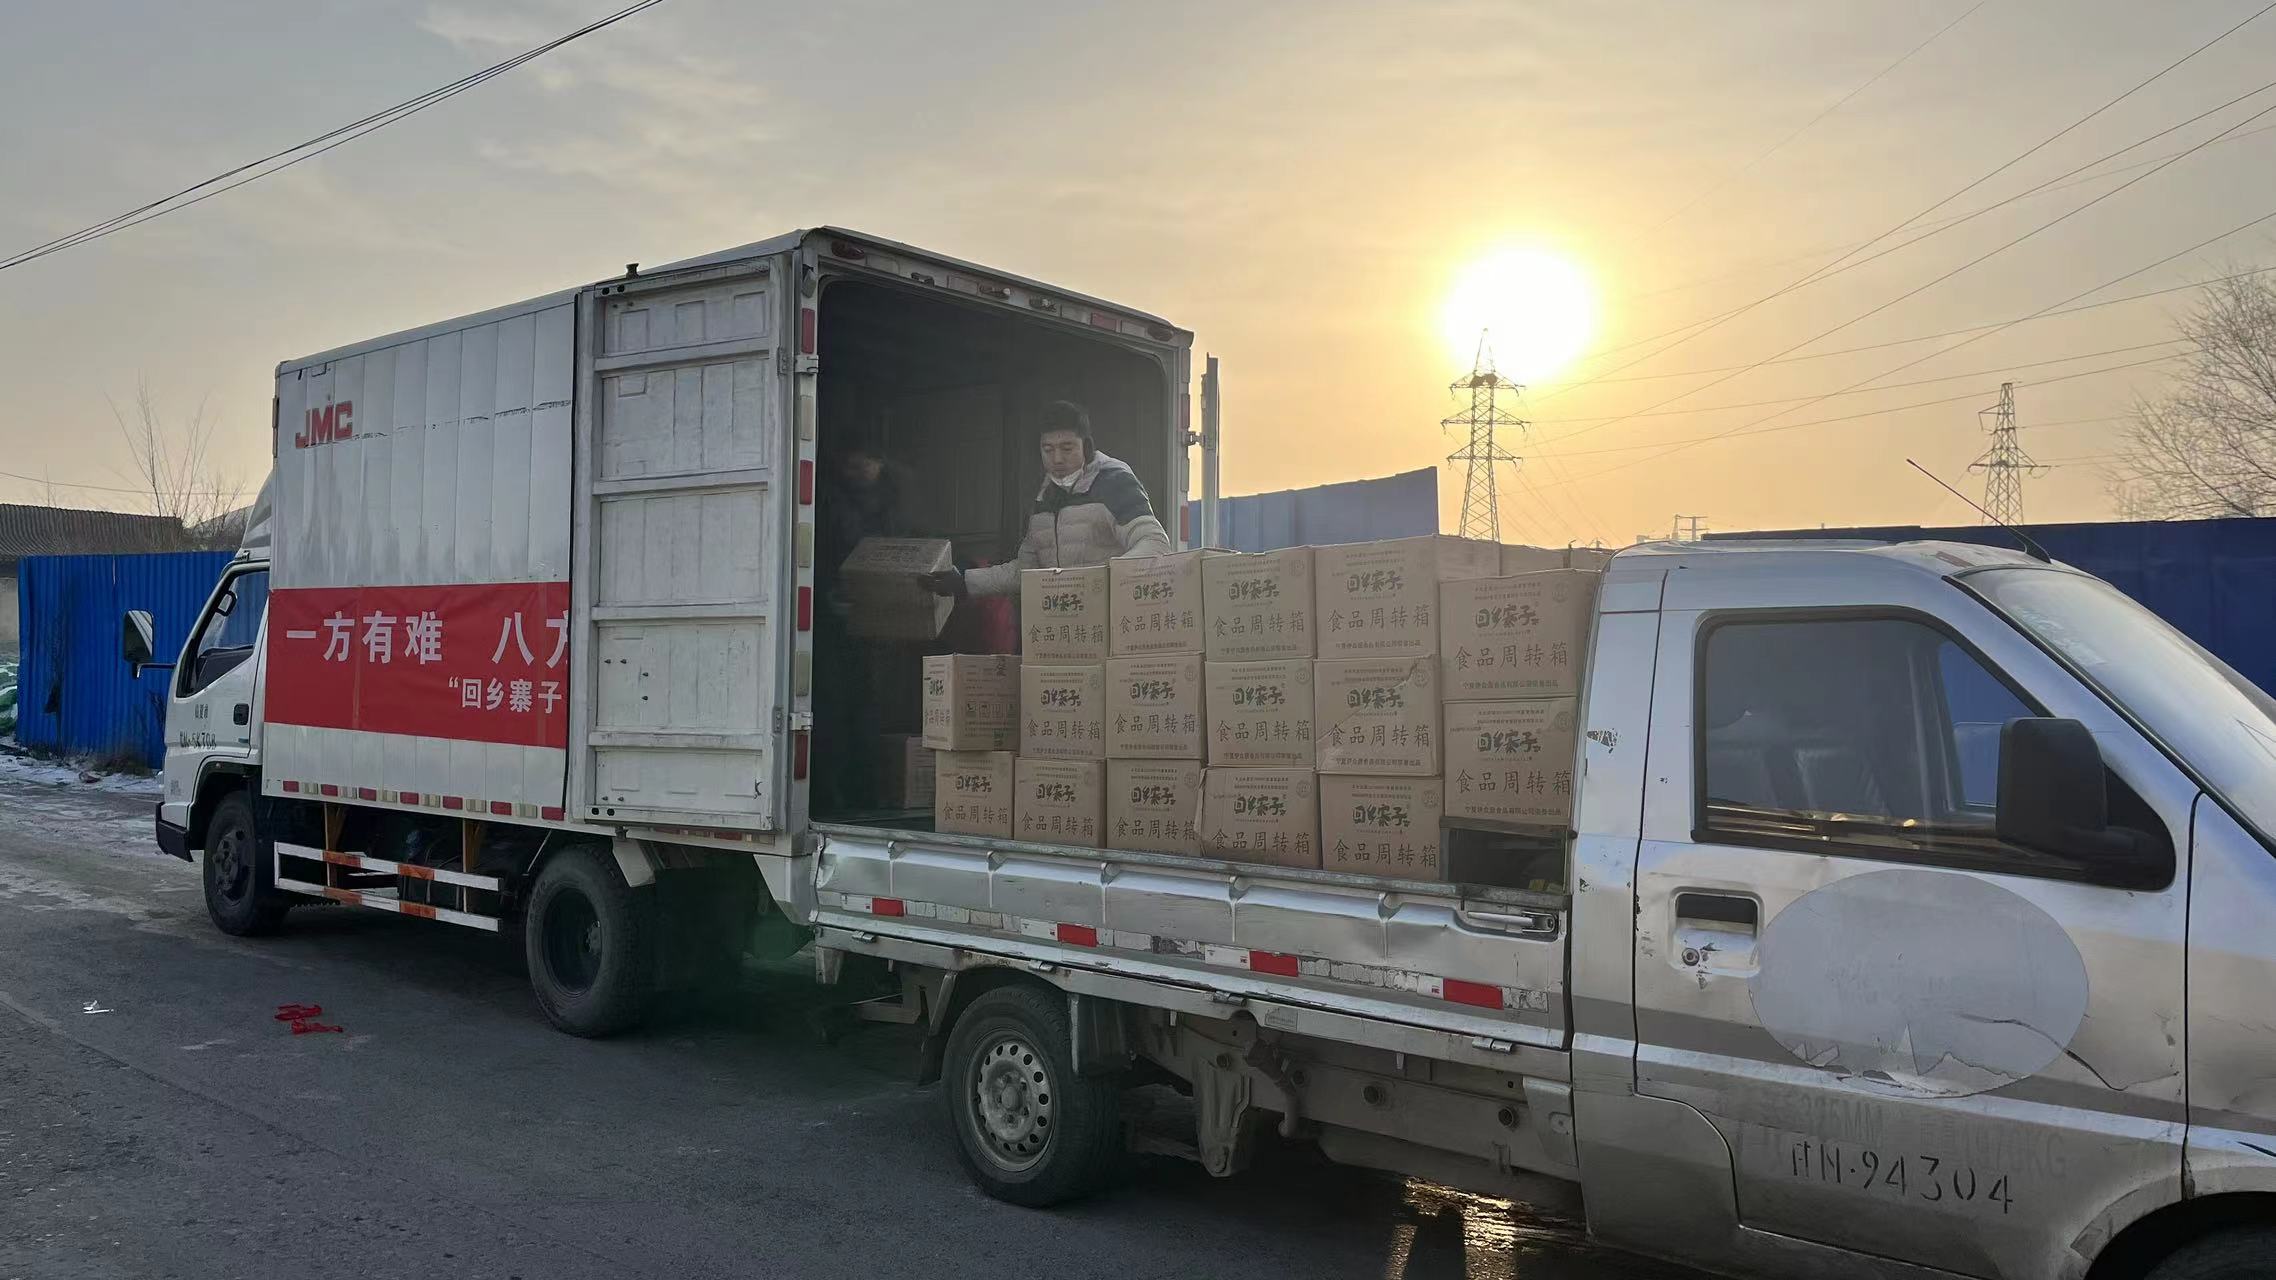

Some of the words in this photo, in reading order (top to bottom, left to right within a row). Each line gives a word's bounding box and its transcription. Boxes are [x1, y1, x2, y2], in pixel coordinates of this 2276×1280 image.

[295, 400, 353, 450] JMC
[1120, 611, 1193, 634] 食品周转箱
[1214, 611, 1304, 639] 食品周转箱
[1327, 604, 1429, 633] 食品周转箱
[287, 611, 444, 665] 一方有难
[1027, 624, 1103, 644] 食品周转箱
[1454, 642, 1568, 672] 食品周转箱
[1027, 719, 1100, 740] 食品周转箱
[1114, 713, 1195, 734] 食品周转箱
[1216, 720, 1310, 742] 食品周转箱
[1328, 724, 1430, 748] 食品周转箱
[1455, 769, 1571, 795] 食品周转箱
[943, 800, 1008, 824] 食品周转箱
[1021, 811, 1094, 836] 食品周转箱
[1114, 817, 1196, 840] 食品周转箱
[1212, 829, 1310, 855] 食品周转箱
[1334, 839, 1437, 868] 食品周转箱
